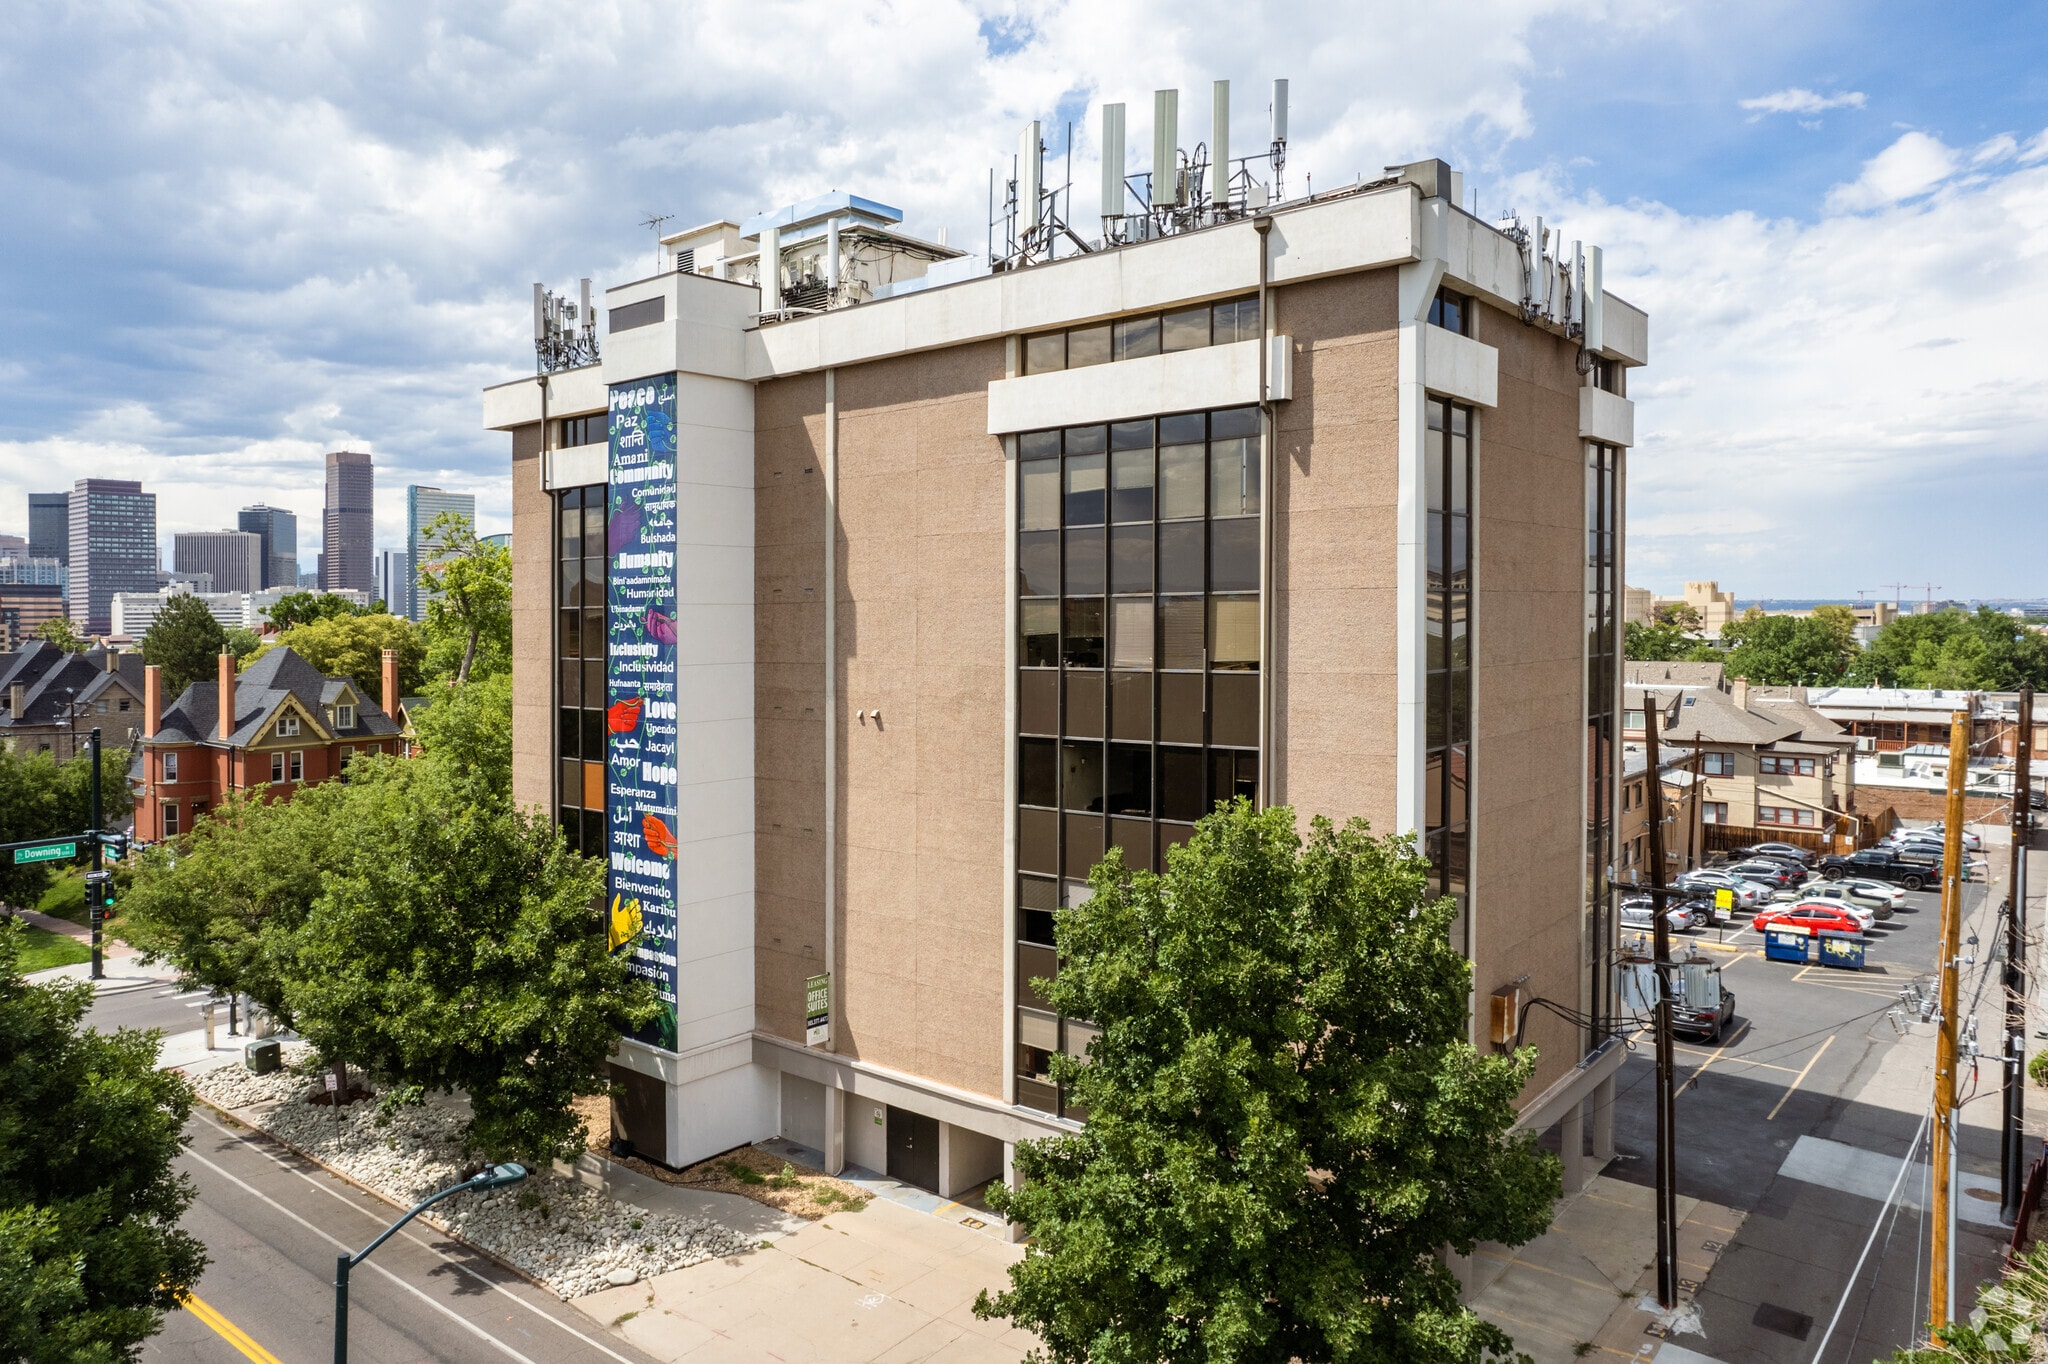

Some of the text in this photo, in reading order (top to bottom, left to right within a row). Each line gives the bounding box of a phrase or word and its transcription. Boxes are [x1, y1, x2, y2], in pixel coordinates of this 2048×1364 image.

[610, 386, 655, 411] Peace
[616, 414, 638, 429] Paz
[614, 449, 648, 466] Amani
[610, 462, 674, 485] Community
[632, 483, 676, 497] Comunidad
[641, 531, 676, 544] Bulshada
[619, 550, 674, 569] Humanity
[609, 642, 659, 657] Inclusivity
[619, 660, 674, 673] Inclusividad
[644, 697, 677, 720] Love
[646, 723, 676, 735] Upendo
[615, 737, 641, 753] حب
[645, 740, 675, 756] Jacayl
[611, 753, 641, 767] Amor
[642, 761, 677, 785] Hope
[610, 783, 657, 799] Esperanza
[635, 801, 677, 816] Matumaini
[613, 831, 641, 848] आशा
[24, 847, 61, 859] Downing
[611, 851, 670, 880] Welcome
[615, 876, 671, 898] Bienvenido
[642, 900, 677, 918] Karibu
[632, 945, 677, 967] mpassion
[625, 961, 669, 981] mpasión
[807, 978, 828, 989] LEASING
[807, 988, 828, 1002] OFFICE
[807, 999, 828, 1013] SUITES
